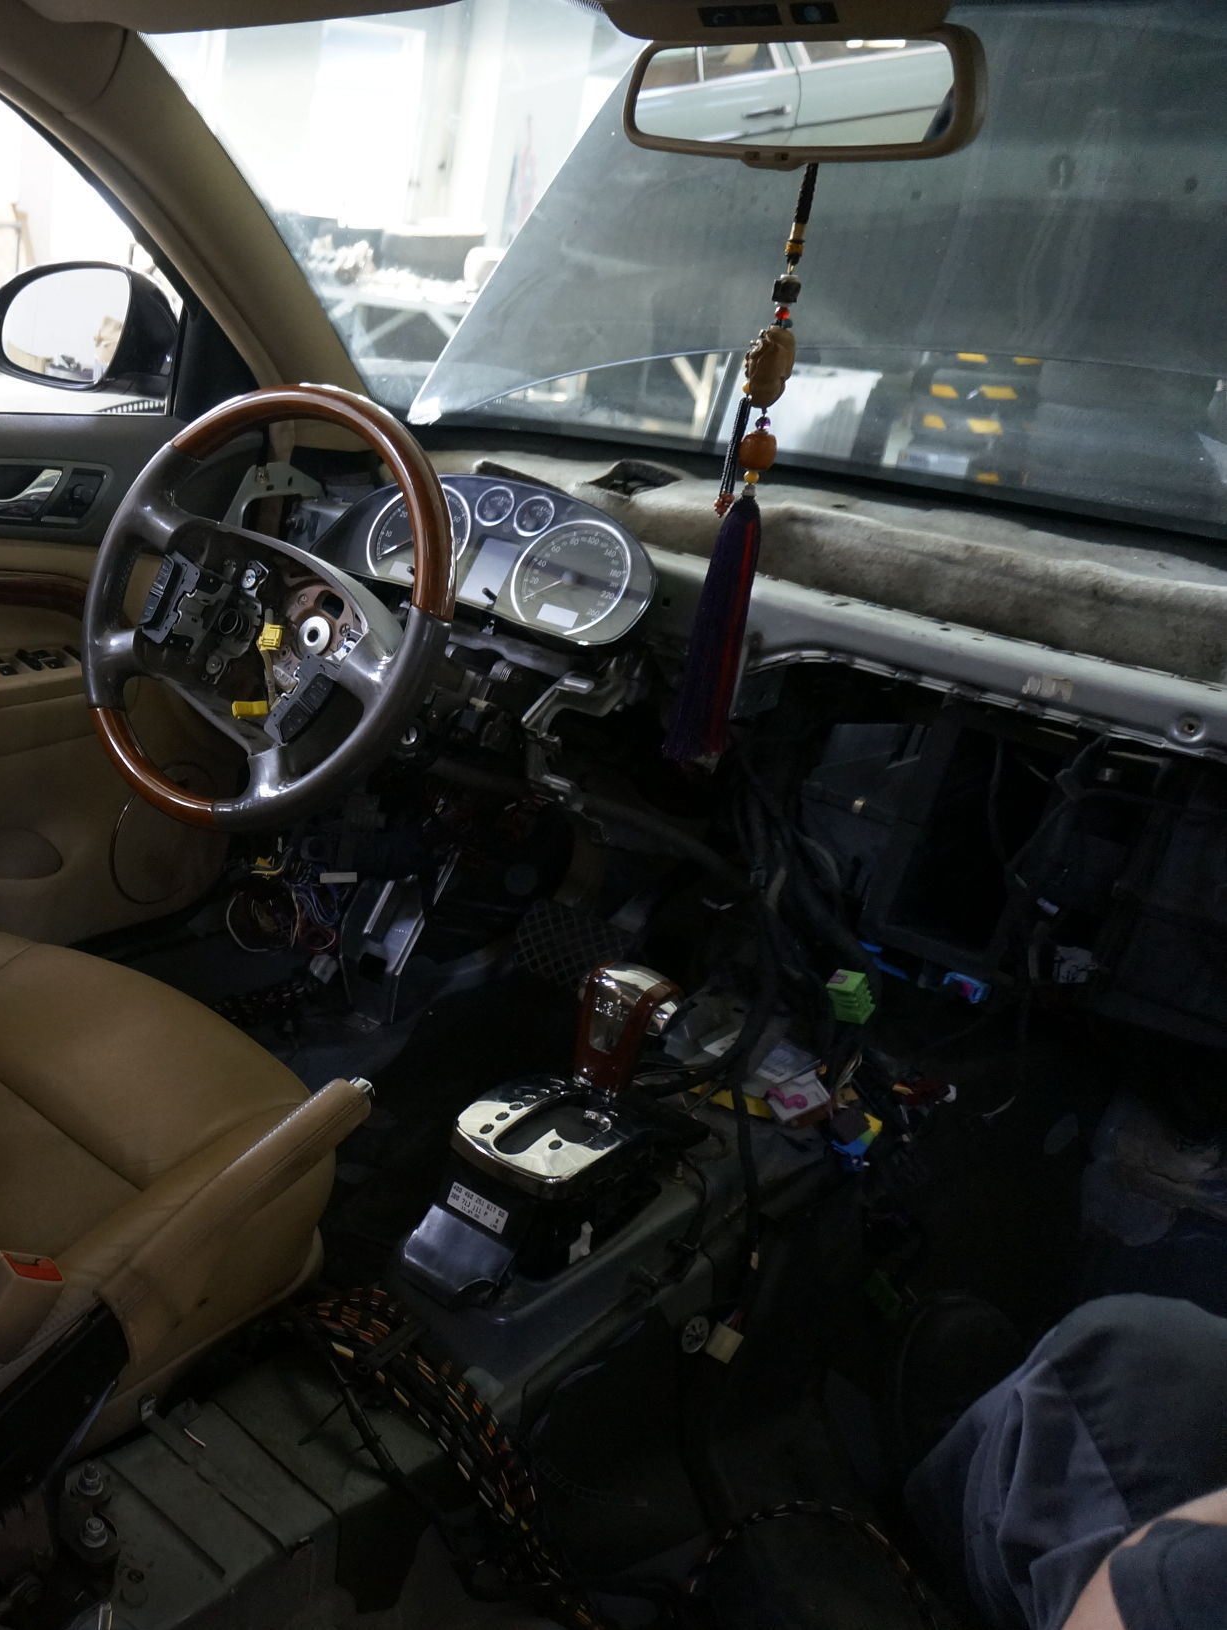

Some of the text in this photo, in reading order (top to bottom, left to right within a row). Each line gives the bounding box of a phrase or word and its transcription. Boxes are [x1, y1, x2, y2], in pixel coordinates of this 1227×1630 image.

[550, 545, 561, 554] 60
[537, 559, 547, 567] 40
[600, 590, 615, 600] 220
